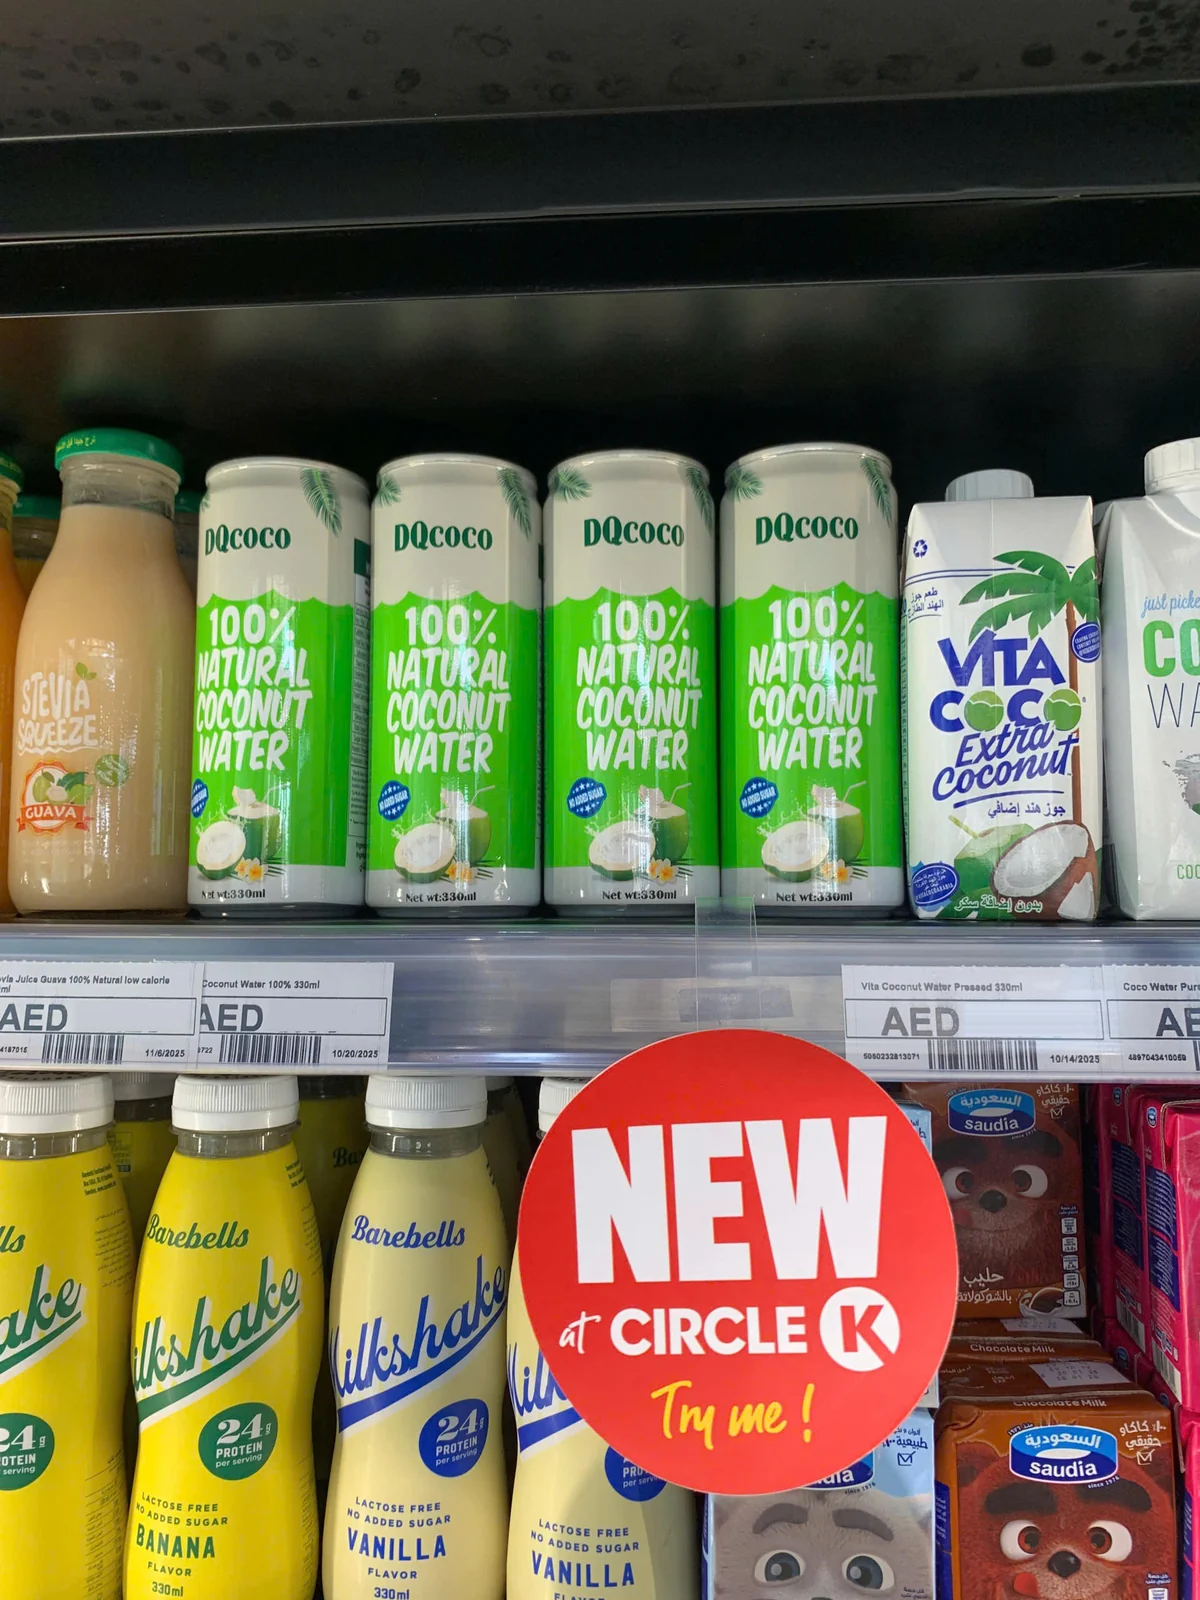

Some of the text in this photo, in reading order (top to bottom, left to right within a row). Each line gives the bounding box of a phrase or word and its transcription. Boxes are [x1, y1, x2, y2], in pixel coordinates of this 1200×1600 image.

[1141, 593, 1168, 618] just
[209, 604, 297, 647] 100%
[404, 604, 498, 646] 100%
[596, 599, 690, 643] 100%
[768, 596, 865, 640] 100%
[576, 642, 701, 689] NATURAL
[748, 639, 876, 687] NATURAL
[937, 628, 1066, 687] VITA
[197, 645, 311, 691] NATURAL
[387, 647, 509, 692] NATURAL
[22, 671, 91, 721] STEVIA
[748, 683, 878, 729] COCONUT
[196, 687, 313, 733] COCONUT
[386, 688, 512, 734] COCONUT
[576, 685, 703, 731] COCONUT
[18, 714, 99, 748] SQUEEZE
[198, 729, 290, 774] WATER
[393, 731, 494, 775] WATER
[586, 728, 689, 772] WATER
[757, 726, 864, 772] WATER
[955, 722, 1054, 769] Extra
[932, 732, 1079, 802] Coconut
[24, 806, 77, 819] GUAVA
[987, 801, 1066, 818] جوز هند إضافي
[201, 889, 215, 900] Net
[405, 893, 424, 903] Net
[602, 890, 622, 900] Net
[776, 892, 797, 902] Net
[953, 896, 979, 911] سكر
[1015, 898, 1043, 914] بدون
[16, 974, 170, 985] Juice Guava 100% Natural low calorie
[202, 979, 320, 990] Coconut Water 100% 330ml
[861, 982, 879, 991] Vita
[882, 982, 922, 991] Coconut
[924, 982, 951, 991] Water
[995, 983, 1023, 992] 330ml
[1123, 982, 1147, 991] Coco
[1150, 983, 1177, 991] Water
[0, 1003, 68, 1032] AED
[200, 1003, 263, 1032] AED
[881, 1006, 960, 1038] AED
[145, 1049, 185, 1058] 11/6/2025
[332, 1049, 378, 1058] 10/20/2025
[1050, 1055, 1100, 1064] 10/14/2025
[960, 1094, 1023, 1109] السعودية
[1041, 1096, 1070, 1108] حقيقي
[964, 1116, 1019, 1132] saudia
[571, 1115, 888, 1284] NEW
[147, 1214, 249, 1249] Barebells
[351, 1214, 466, 1249] Barebells
[963, 1266, 1005, 1288] حليب
[559, 1311, 602, 1354] at
[610, 1305, 808, 1356] CIRCLE
[970, 1344, 1056, 1353] Chocolate Milk
[1082, 1399, 1108, 1408] Milk
[650, 1380, 816, 1450] Try me !
[1120, 1420, 1149, 1438] كاكاو
[216, 1441, 263, 1458] PROTEIN
[436, 1435, 478, 1457] PROTEIN
[896, 1435, 928, 1450] طبيعية
[1025, 1433, 1102, 1449] السعودية
[1125, 1436, 1162, 1451] حقيقي
[215, 1453, 263, 1468] per serving
[436, 1447, 478, 1467] per serving
[3, 1466, 35, 1475] serving
[1029, 1461, 1099, 1478] saudia
[623, 1480, 637, 1489] per
[1087, 1475, 1121, 1490] since 1976
[141, 1492, 219, 1513] LACTOSE FREE
[355, 1496, 441, 1513] LACTOSE FREE
[136, 1503, 229, 1527] NO ADDED SUGAR
[347, 1508, 451, 1528] NO ADDED SUGAR
[538, 1518, 630, 1538] LACTOSE FREE
[136, 1523, 216, 1559] BANANA
[347, 1527, 447, 1562] VANILLA
[530, 1530, 640, 1554] NO ADDED SUGAR
[147, 1561, 192, 1577] FLAVOR
[368, 1567, 418, 1580] FLAVOR
[532, 1550, 636, 1588] VANILLA
[152, 1581, 184, 1598] 330ml
[374, 1587, 410, 1600] 330ml
